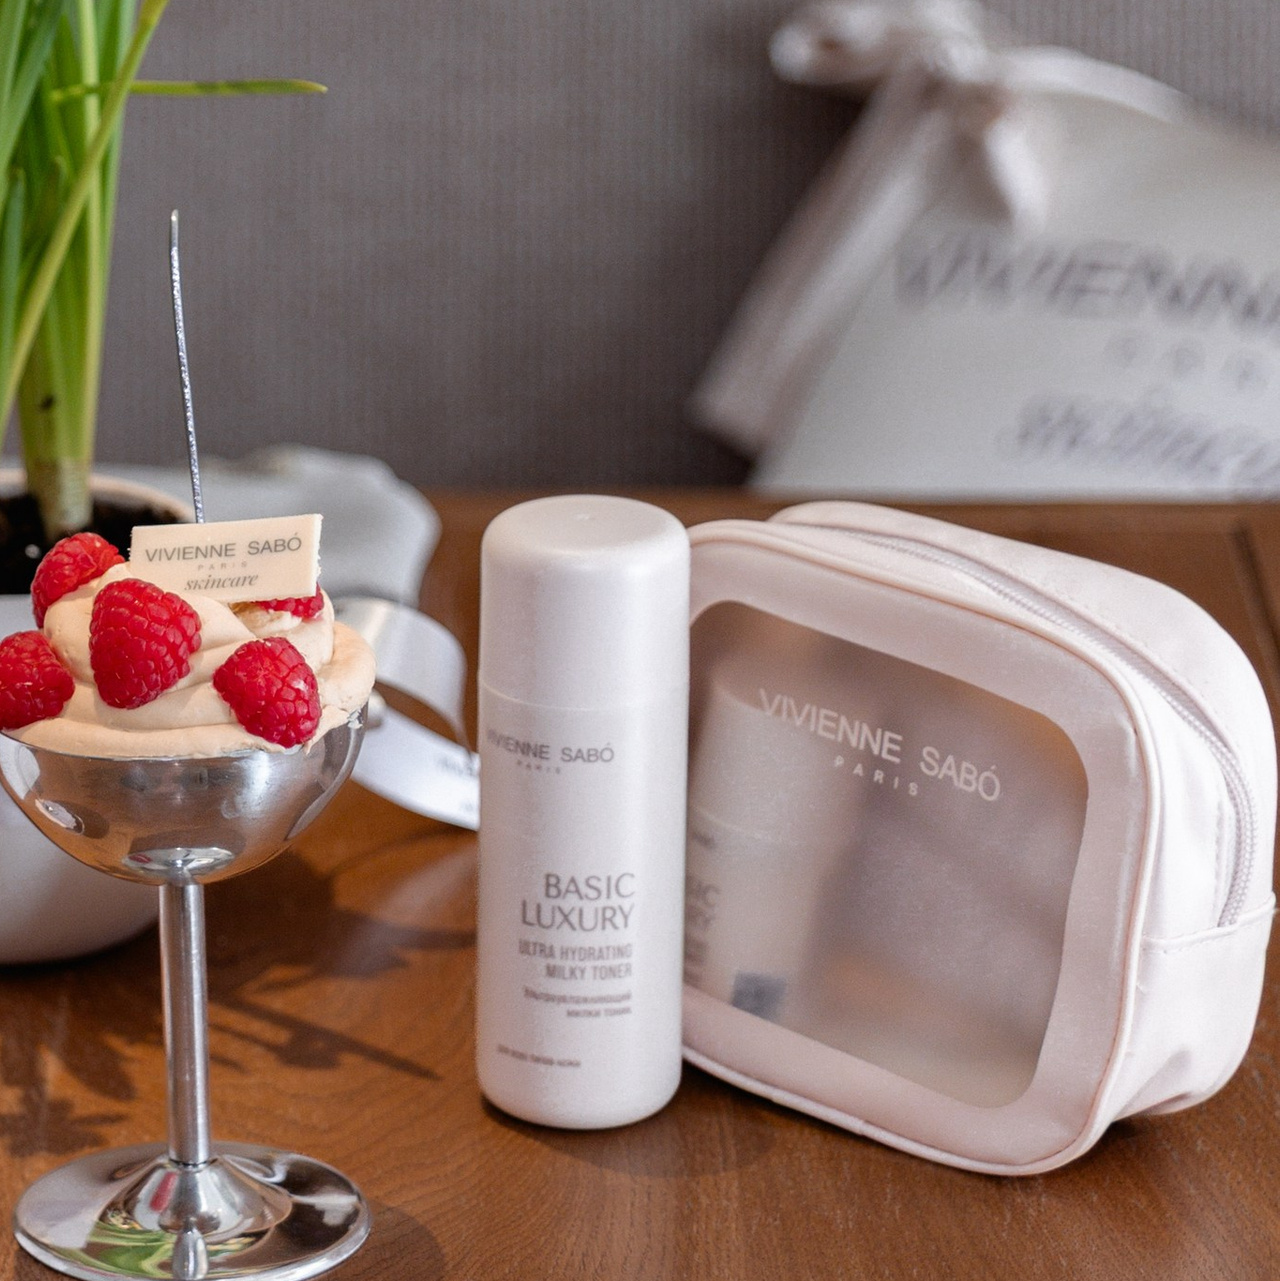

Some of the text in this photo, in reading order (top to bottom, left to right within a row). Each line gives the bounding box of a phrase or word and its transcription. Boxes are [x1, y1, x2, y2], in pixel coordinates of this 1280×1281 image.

[145, 532, 302, 562] VIVIENNE SABÓ
[198, 561, 248, 571] PARIS
[184, 572, 259, 591] skincare
[561, 742, 614, 763] SABÓ
[758, 688, 1001, 802] VIVIENNE SABÓ
[833, 755, 919, 797] PARIS
[544, 872, 635, 900] BASIC
[522, 900, 635, 932] LUXURY
[560, 943, 632, 961] HYDRATING
[546, 962, 632, 980] MILKY TONER
